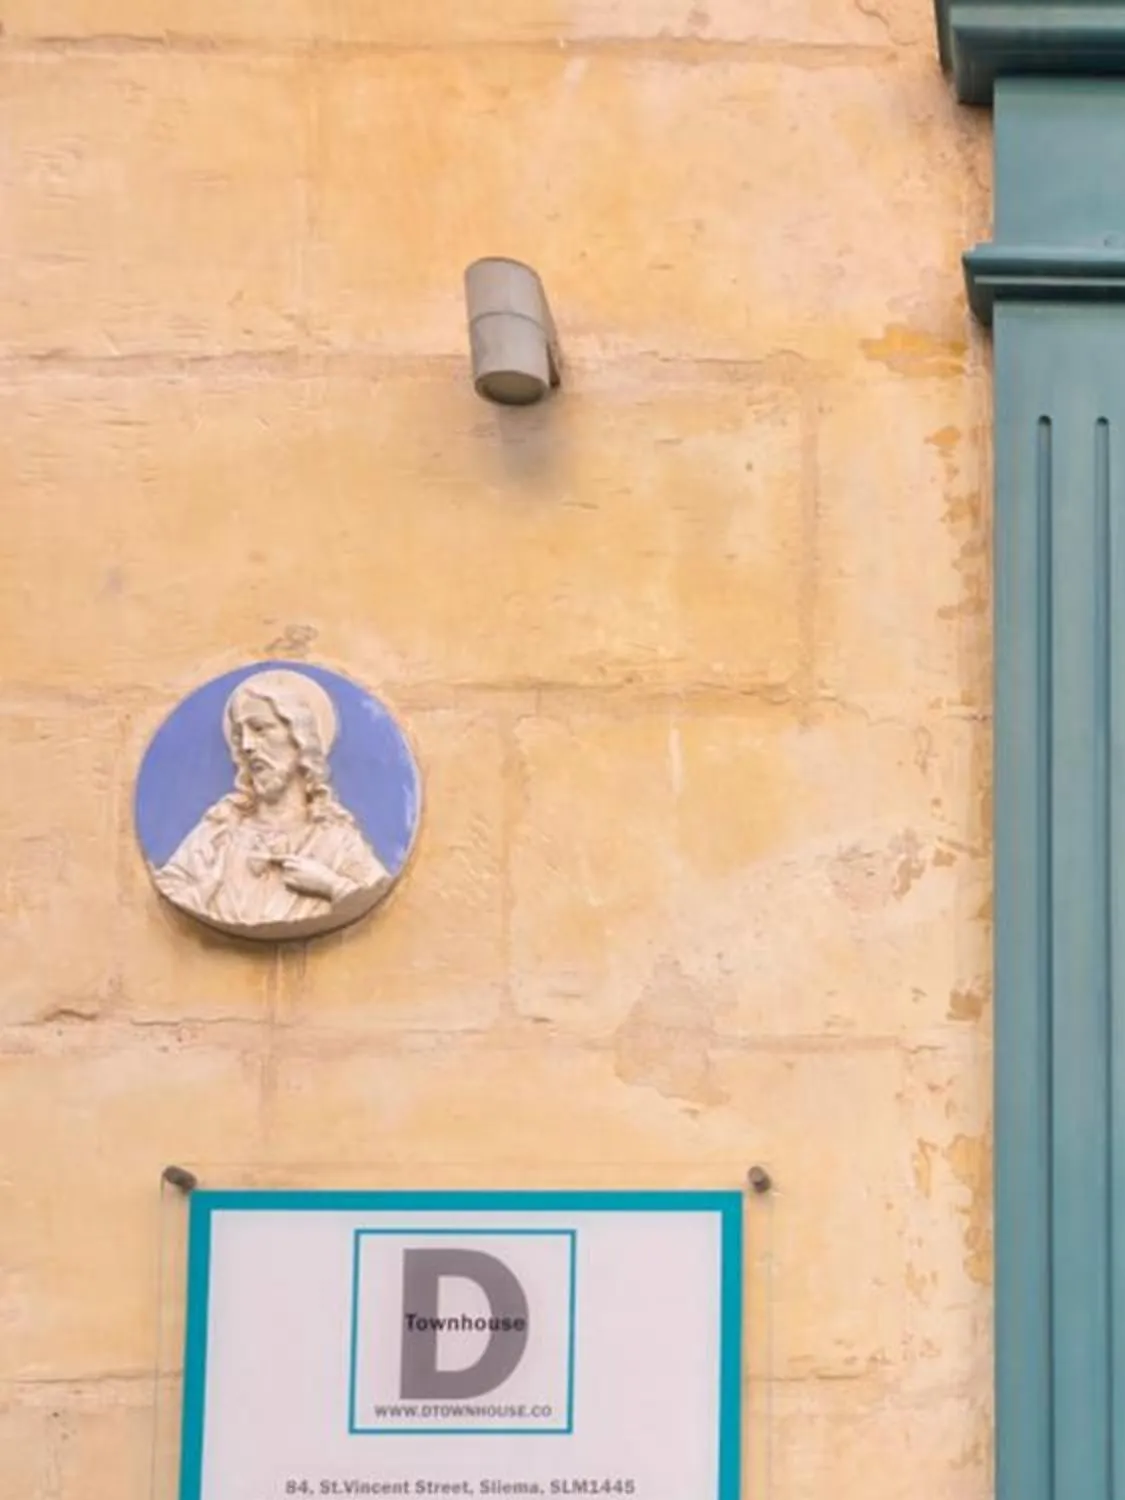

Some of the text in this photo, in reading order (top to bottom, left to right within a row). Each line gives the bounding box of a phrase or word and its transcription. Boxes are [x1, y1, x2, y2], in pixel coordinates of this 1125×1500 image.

[400, 1248, 529, 1400] D
[405, 1314, 526, 1333] Townhouse
[374, 1405, 552, 1418] WWW.DTOWNHOUSE.CO
[415, 1480, 474, 1496] Street,
[550, 1480, 635, 1494] SLM1445
